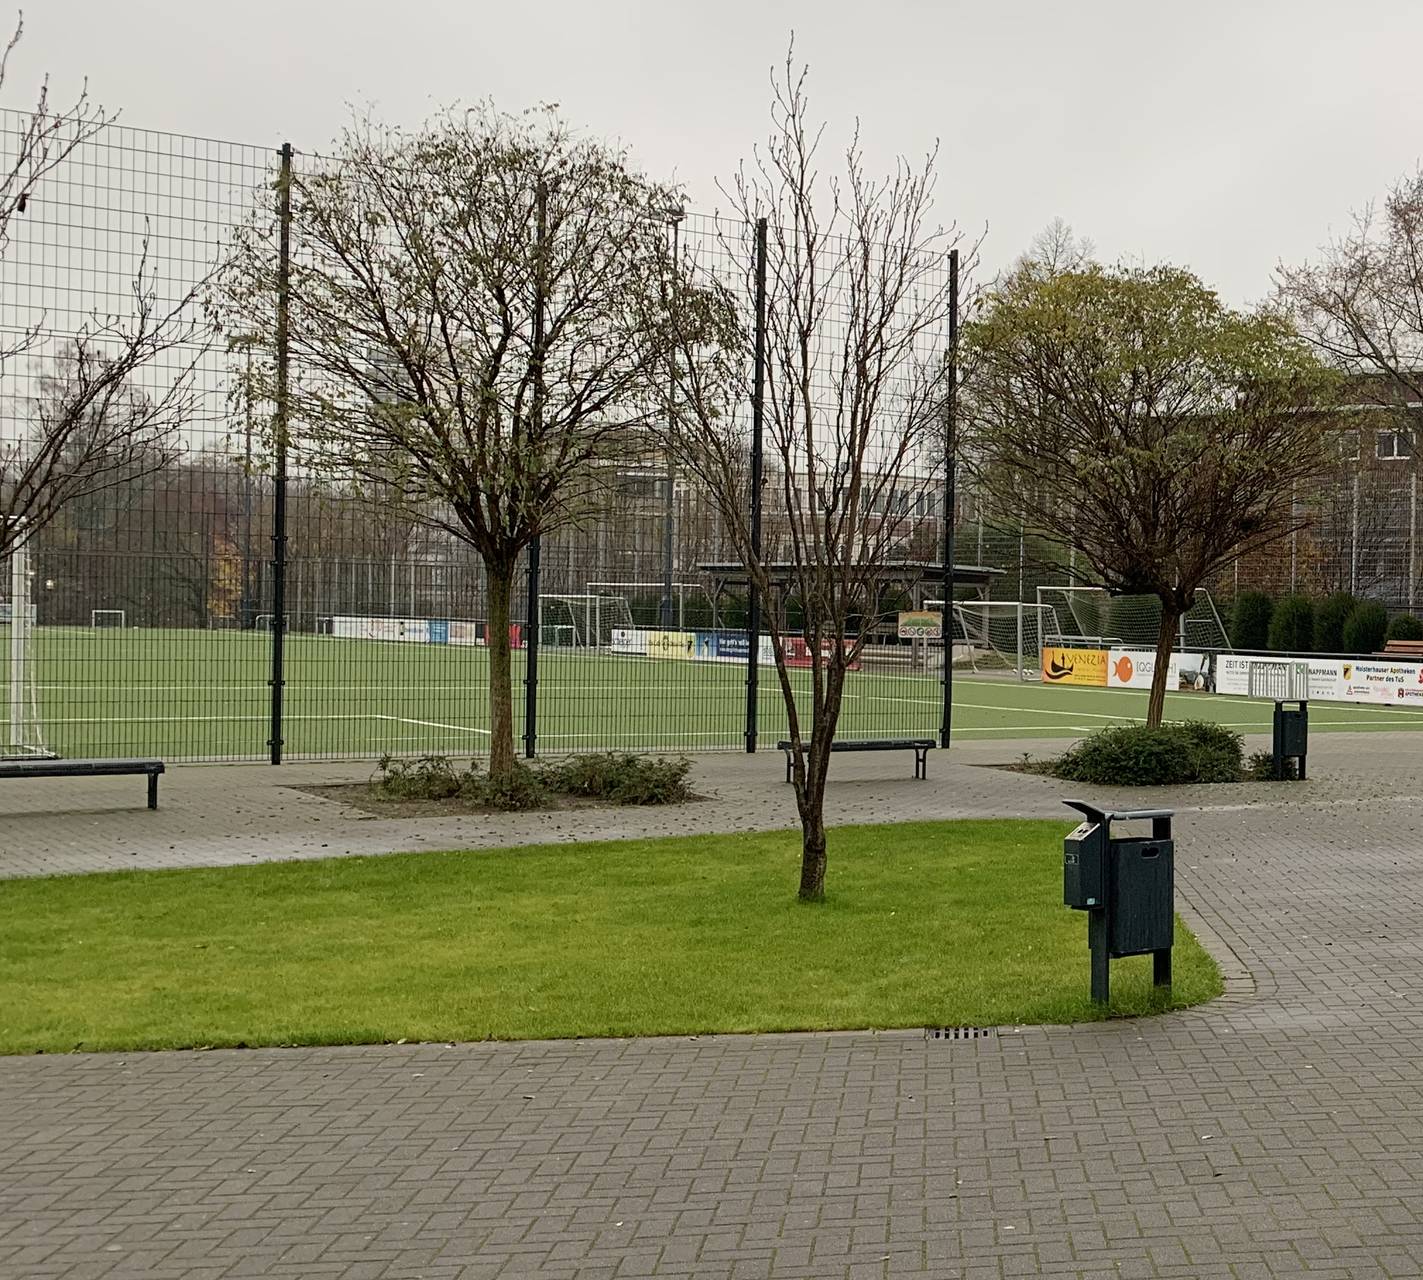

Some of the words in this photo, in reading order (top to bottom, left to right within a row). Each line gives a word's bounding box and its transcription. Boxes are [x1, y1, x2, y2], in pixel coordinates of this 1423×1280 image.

[1066, 653, 1106, 666] VENEZIA
[1225, 660, 1238, 669] ZEIT
[1366, 674, 1385, 682] Partner
